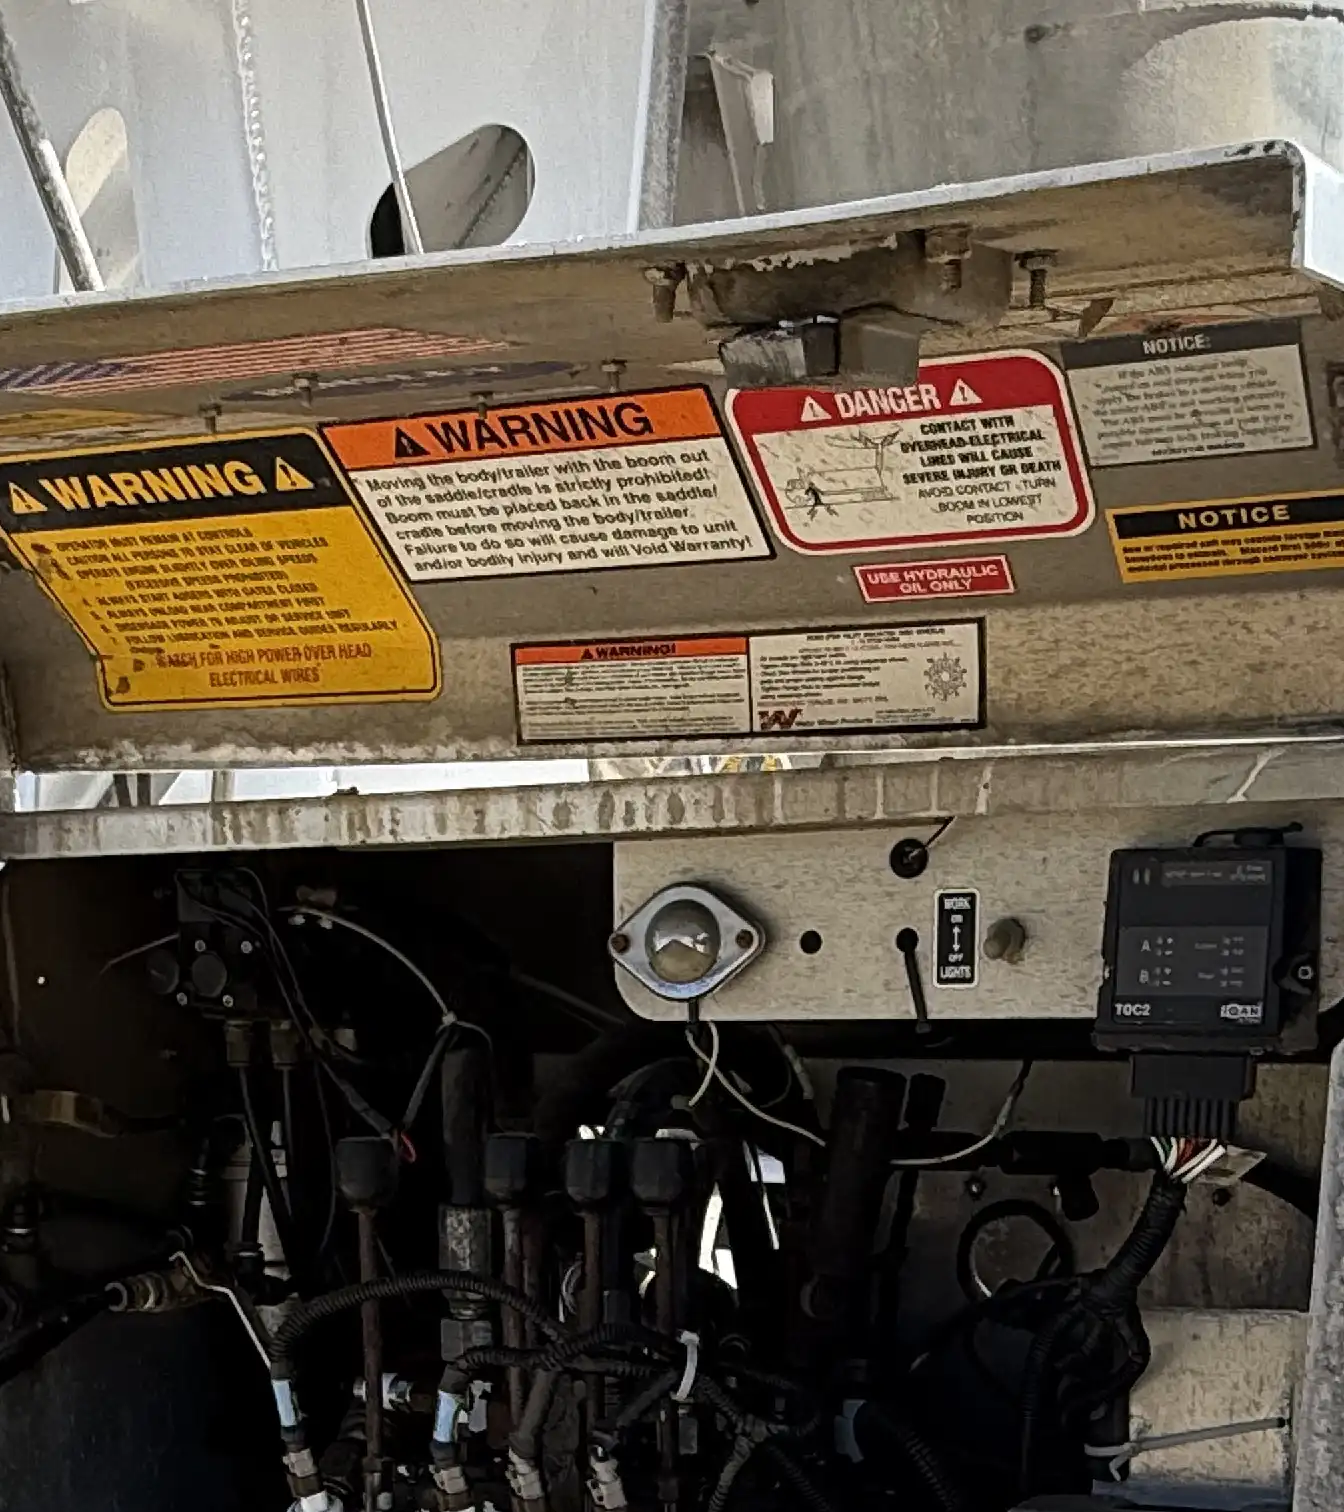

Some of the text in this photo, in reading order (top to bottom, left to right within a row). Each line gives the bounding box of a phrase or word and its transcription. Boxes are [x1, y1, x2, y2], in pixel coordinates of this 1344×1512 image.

[834, 383, 942, 419] DANGER
[430, 402, 654, 454] WARNING
[920, 415, 1014, 435] CONTACT WITH
[969, 429, 1045, 446] ELECTRICAL
[958, 451, 989, 464] WILL
[991, 446, 1033, 460] CAUSE
[366, 449, 710, 492] Moving the body/trailer with the boom out
[903, 460, 1062, 485] SEVERE INJURY OR DEATH
[40, 459, 267, 512] WARNING
[377, 468, 711, 508] of the saddle/cradle is strictly prohibited!
[918, 486, 954, 499] AVOID
[957, 481, 1011, 495] CONTACT
[1021, 477, 1056, 489] TURN
[385, 511, 433, 524] Boom
[436, 506, 477, 520] must
[477, 504, 500, 517] be
[502, 499, 556, 517] placed
[561, 495, 601, 510] back
[602, 494, 620, 507] in
[623, 492, 651, 504] the
[939, 494, 1042, 512] BOOM IN LOWEST
[396, 527, 443, 540] cradle
[445, 522, 497, 535] before
[500, 517, 561, 532] moving
[563, 515, 589, 526] the
[967, 511, 1023, 524] POSITION
[1178, 504, 1290, 529] NOTICE
[404, 520, 738, 556] Failure to do so will cause damage to unit
[415, 558, 463, 572] and/or
[466, 555, 514, 568] bodily
[567, 547, 598, 560] and
[601, 545, 629, 558] will
[630, 542, 668, 556] Void
[669, 535, 754, 552] Warranty!
[867, 563, 1000, 586] USE HYDRAULIC
[899, 577, 972, 594] OIL ONLY
[201, 651, 223, 667] FOR
[226, 649, 255, 665] HIGH
[258, 646, 302, 663] POWER
[304, 644, 336, 662] OVER
[339, 642, 372, 658] HEAD
[596, 643, 677, 659] WARNING!
[209, 666, 320, 688] ELECTRICAL WIRES
[1140, 938, 1152, 952] A
[940, 965, 972, 979] LIGHTS
